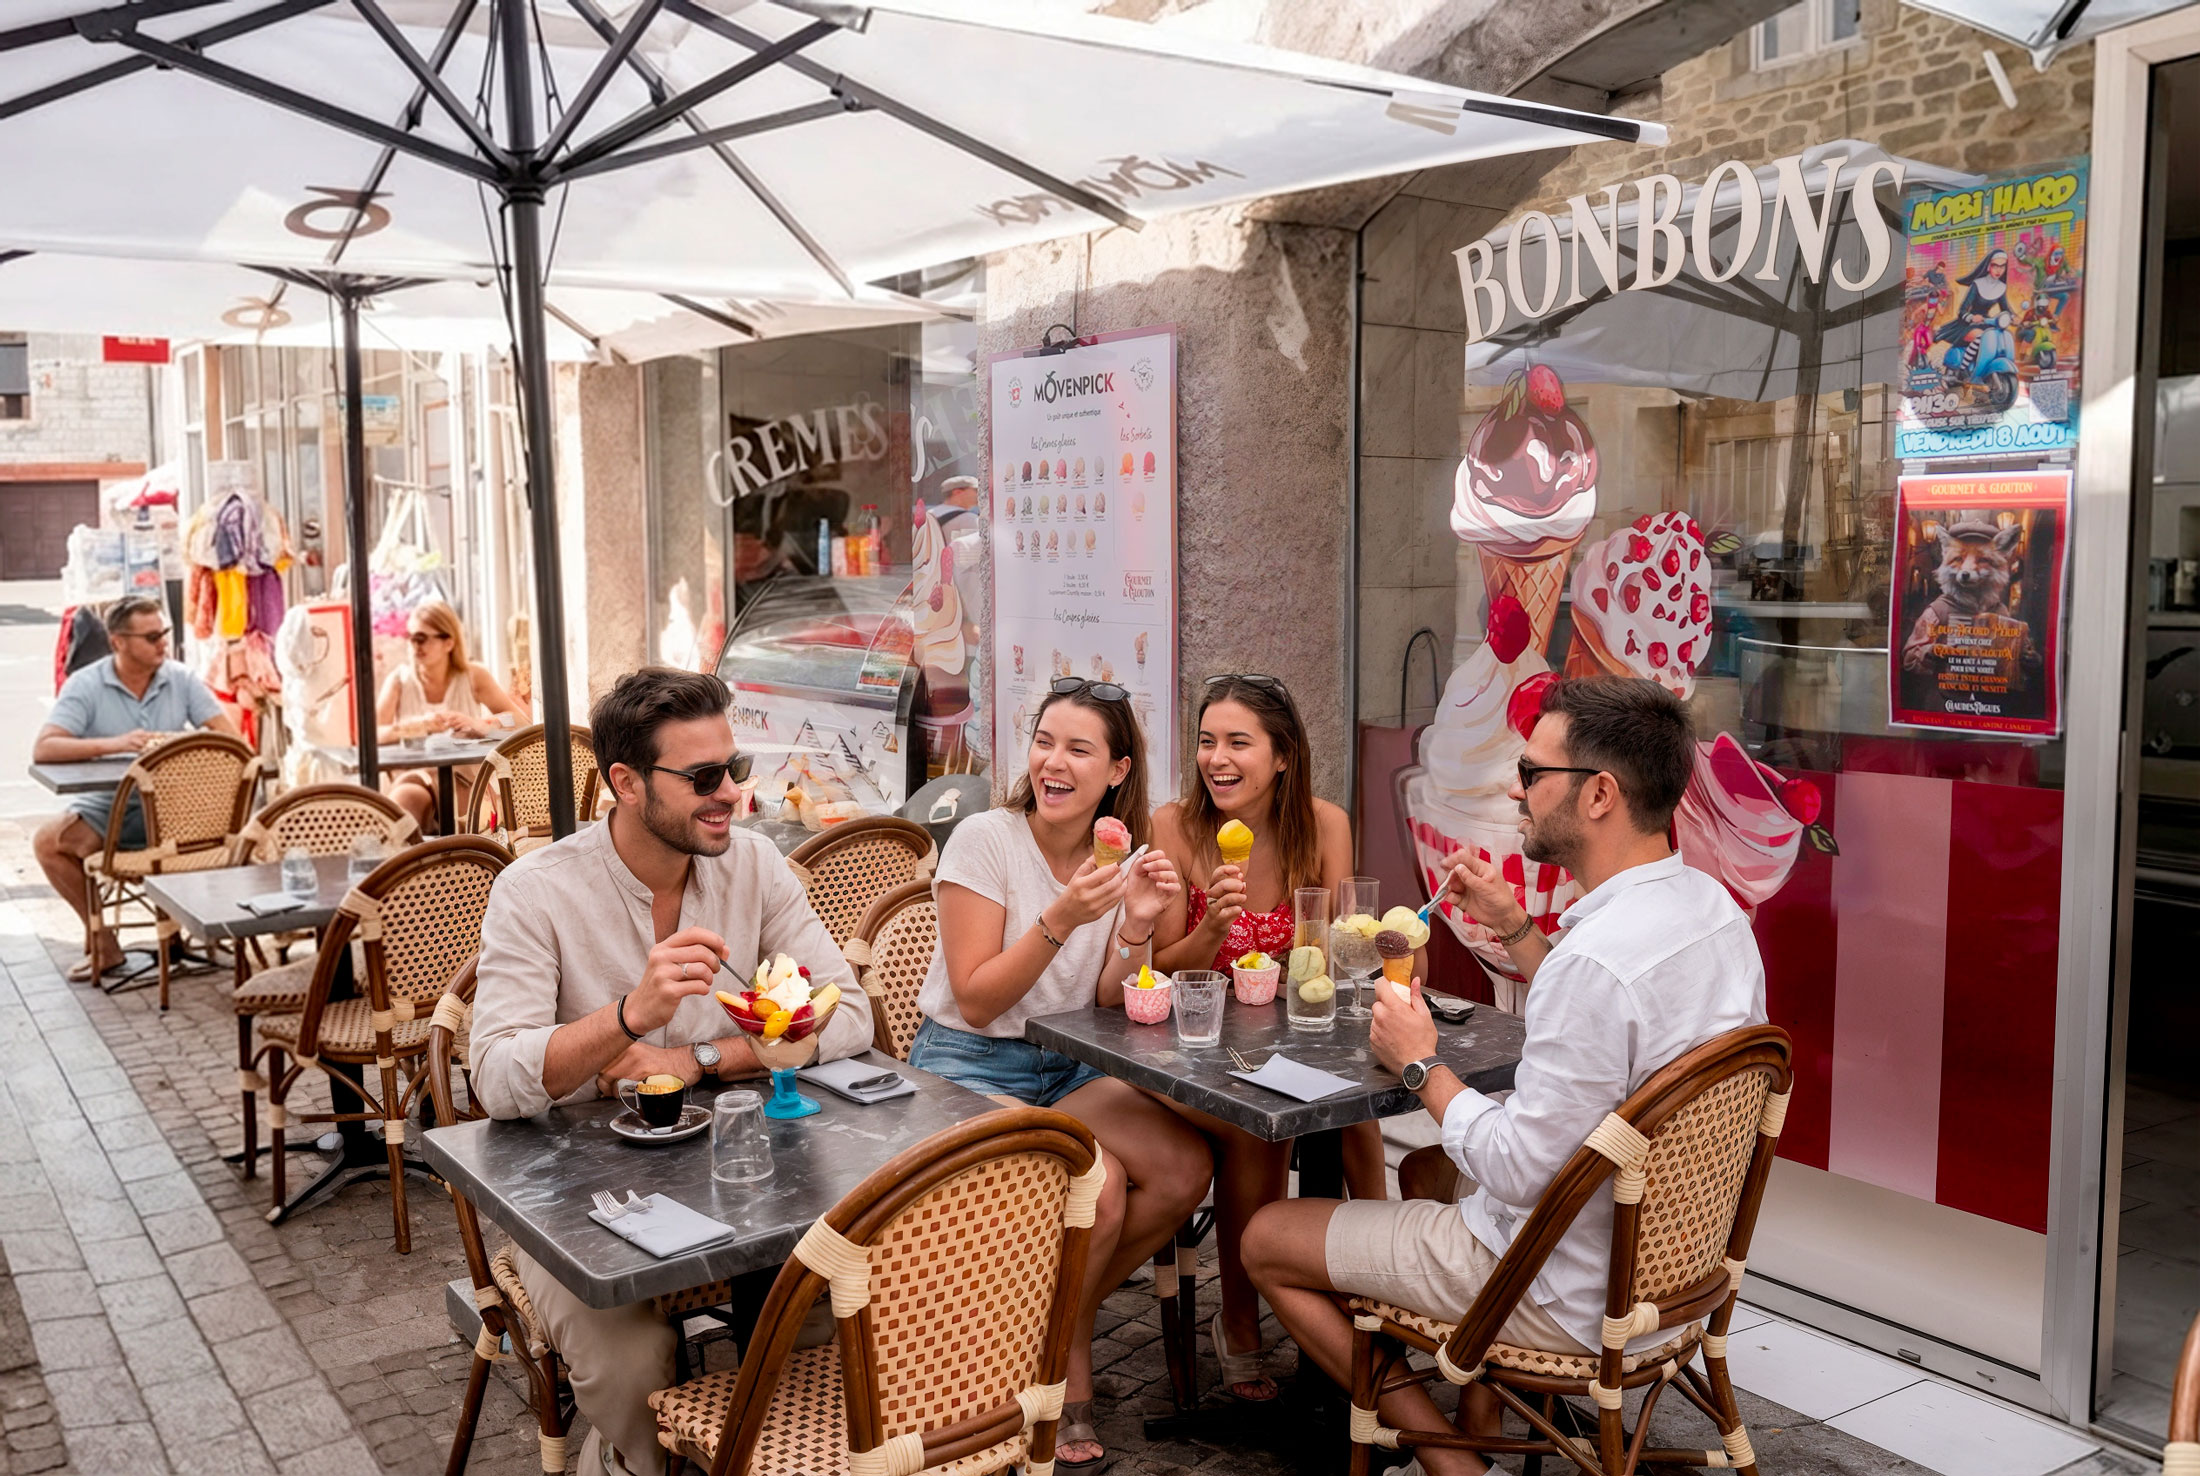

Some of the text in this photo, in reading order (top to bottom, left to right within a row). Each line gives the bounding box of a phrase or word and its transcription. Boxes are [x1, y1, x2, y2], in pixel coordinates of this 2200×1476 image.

[1451, 154, 1906, 346] BONBONS
[1902, 426, 1993, 454] VENDREDI
[1996, 424, 2012, 447] 8
[1930, 481, 2033, 496] GOURMET & GLOUTON
[1124, 572, 1152, 590] GOURMET
